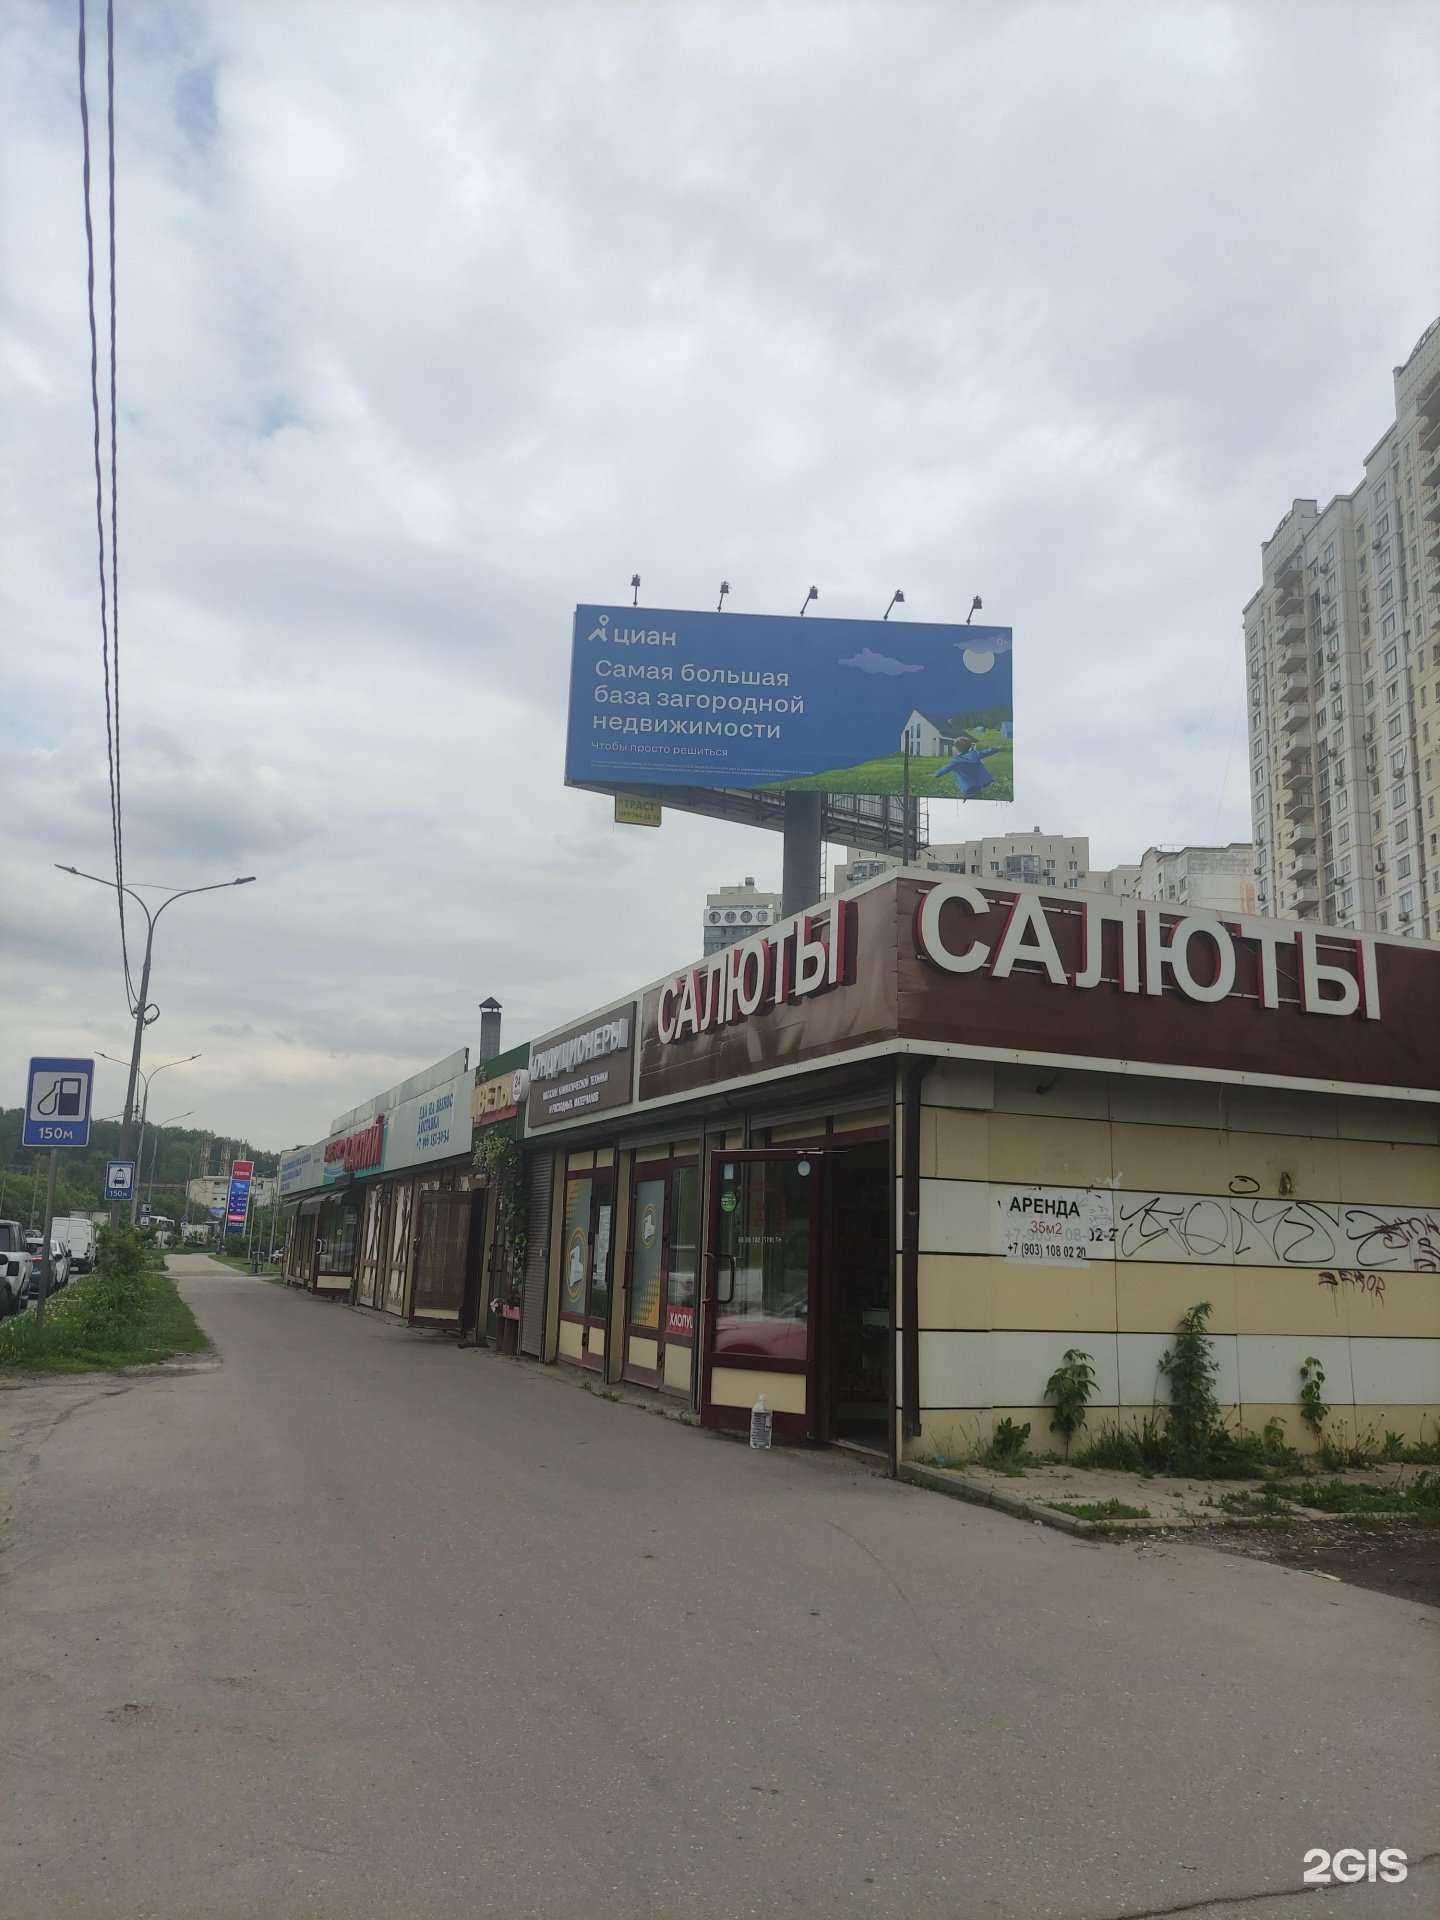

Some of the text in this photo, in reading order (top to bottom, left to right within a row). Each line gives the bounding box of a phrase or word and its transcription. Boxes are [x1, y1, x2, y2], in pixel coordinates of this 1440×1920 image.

[613, 627, 677, 647] циан
[595, 659, 789, 687] Самая большая
[594, 684, 805, 715] база загородной
[592, 714, 781, 739] недвижимости
[591, 740, 729, 758] Чтобы просто решиться
[921, 883, 1382, 1021] САЛЮТЫ
[657, 899, 843, 1045] САЛЮТЫ
[39, 1127, 73, 1140] 150м
[1009, 1196, 1080, 1219] АРЕНДА
[1031, 1220, 1063, 1235] 35м2
[1007, 1242, 1019, 1255] +7
[1021, 1242, 1043, 1258] (903)
[1046, 1245, 1061, 1257] 108
[1063, 1245, 1074, 1258] 02
